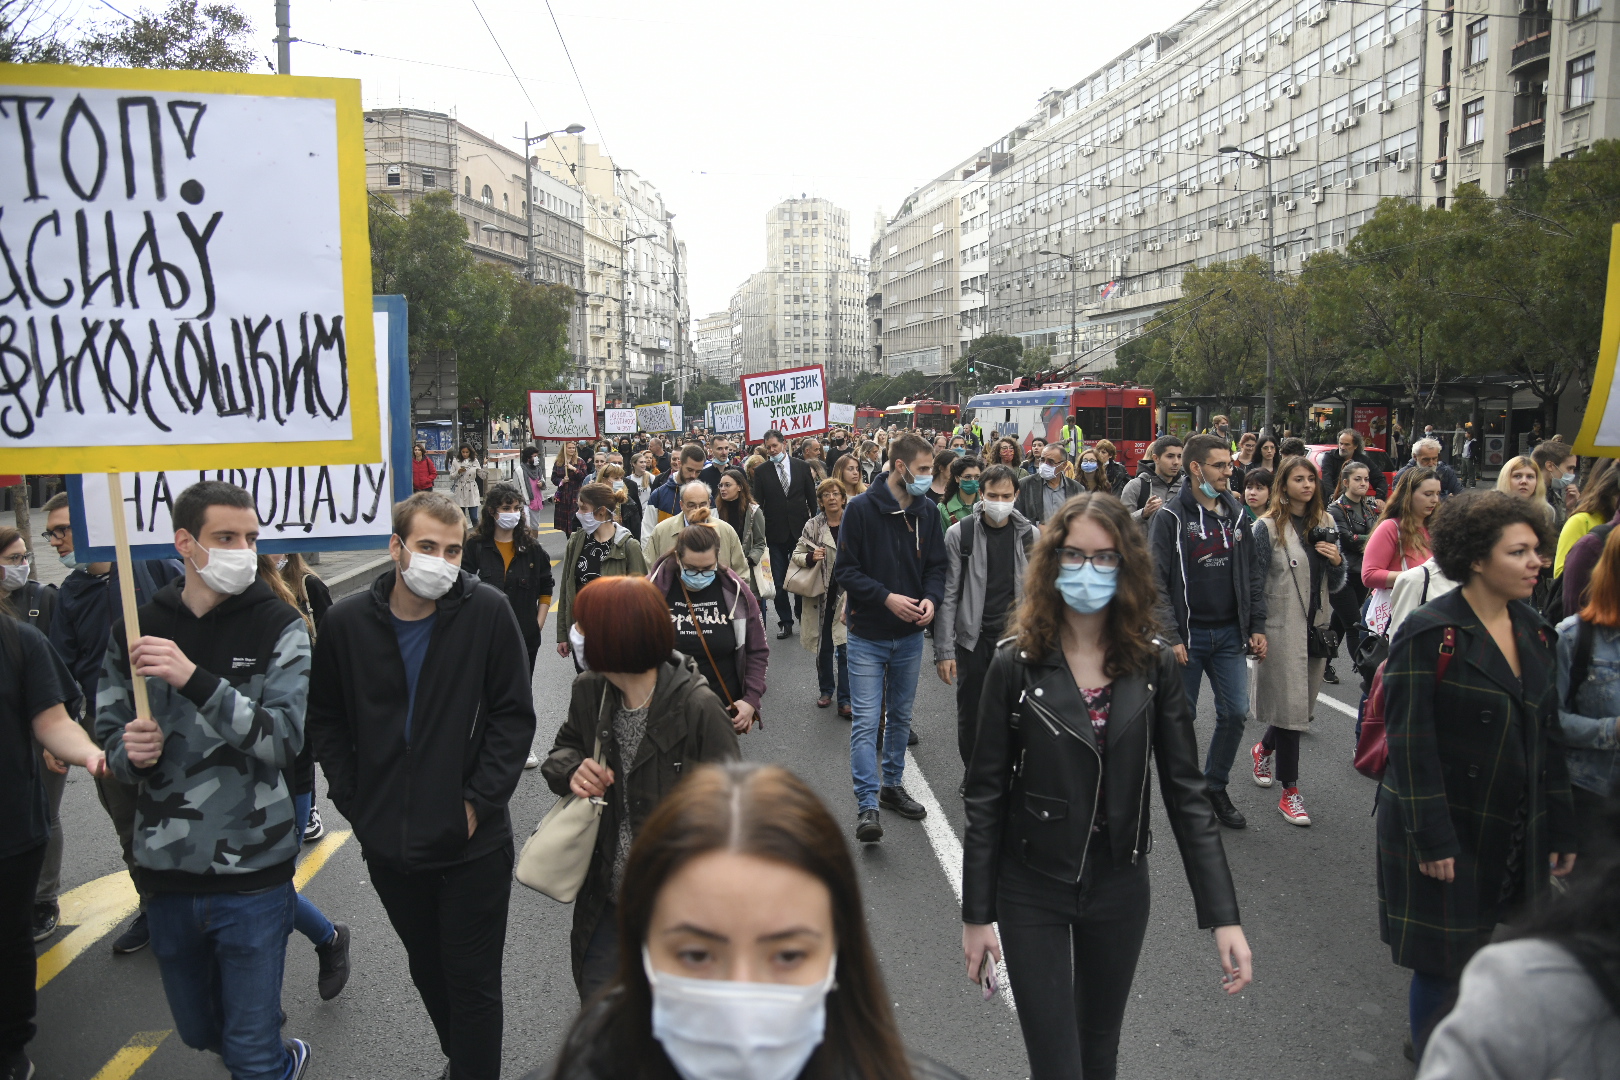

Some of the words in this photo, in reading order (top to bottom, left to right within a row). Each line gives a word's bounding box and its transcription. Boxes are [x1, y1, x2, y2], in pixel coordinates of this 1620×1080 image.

[748, 378, 786, 396] СРПСКИ
[790, 374, 819, 390] ЈЕЗИК
[752, 393, 796, 408] НАЈВИШЕ
[770, 400, 824, 418] УГРОЖАВАЈУ
[124, 471, 174, 532] НА
